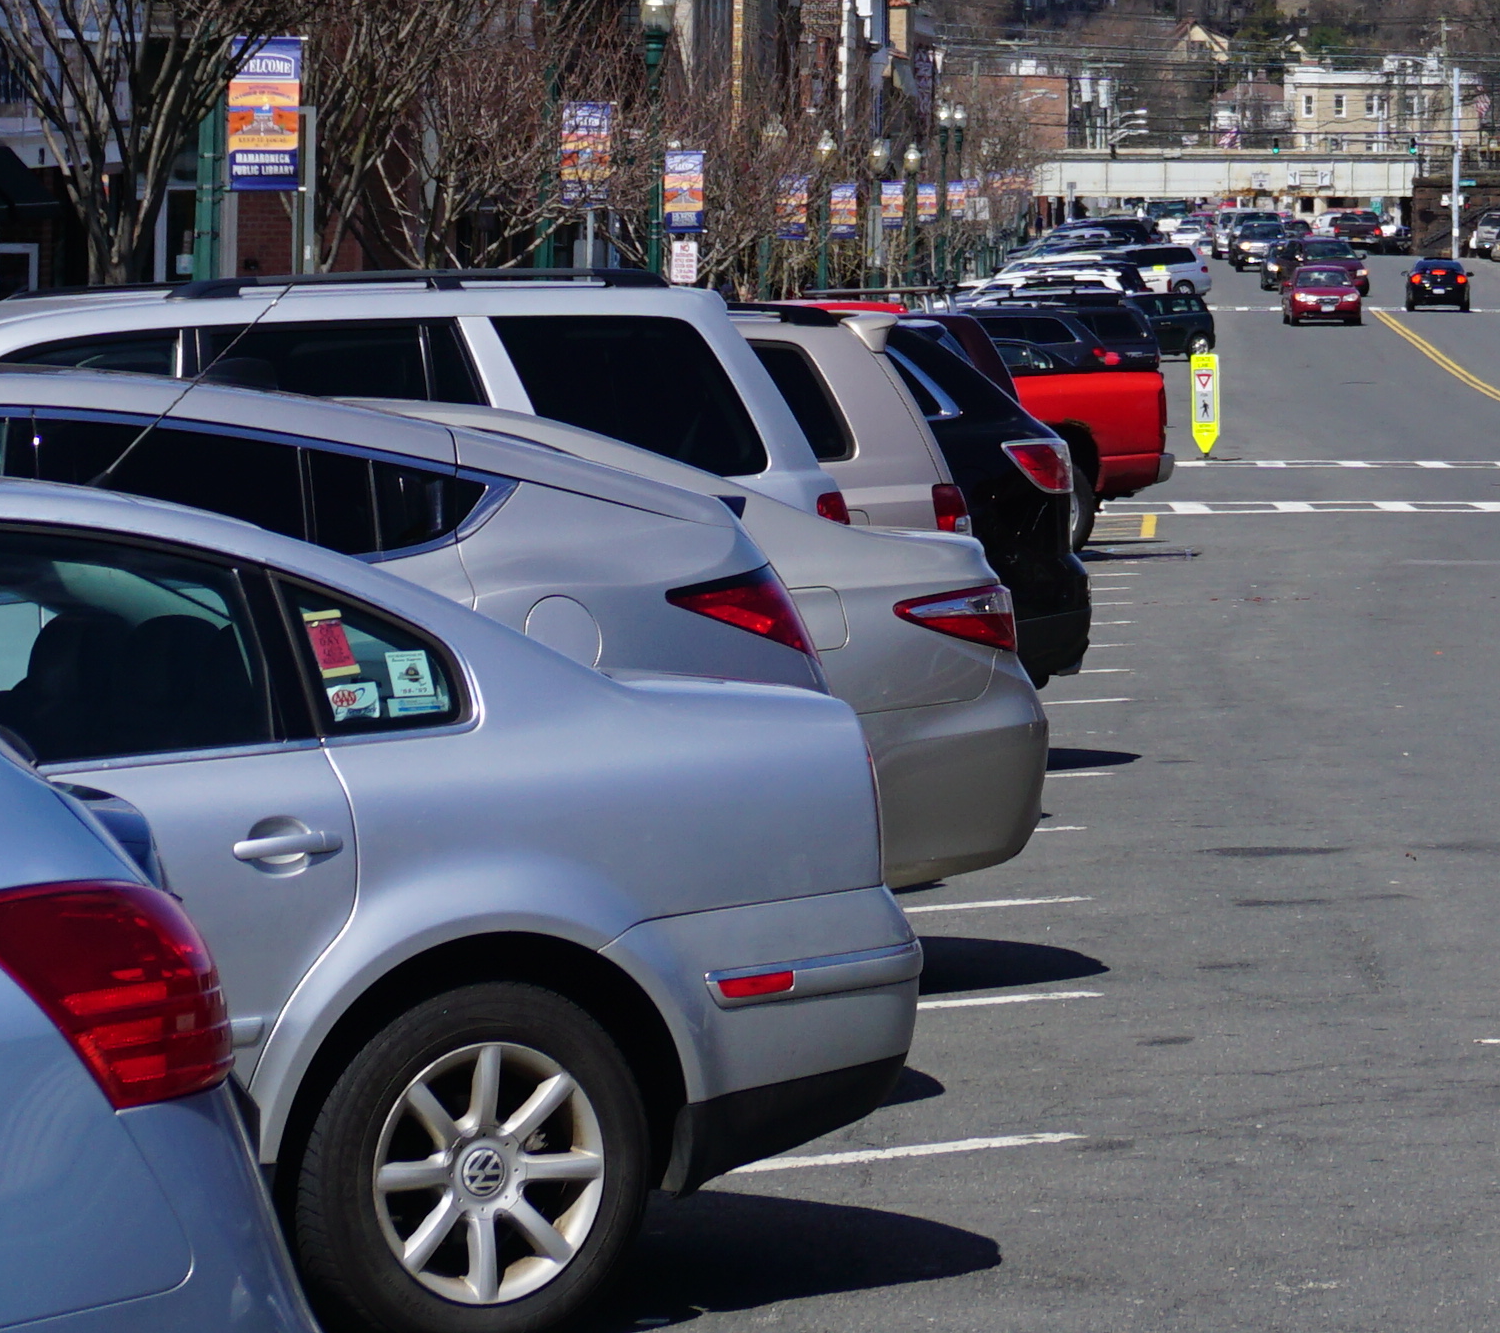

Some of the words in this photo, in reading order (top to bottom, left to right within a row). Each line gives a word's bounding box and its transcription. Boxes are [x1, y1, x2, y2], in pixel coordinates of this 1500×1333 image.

[235, 152, 290, 164] MAMARONECK
[232, 165, 259, 175] PUBLIC
[261, 165, 294, 175] LIBRARY
